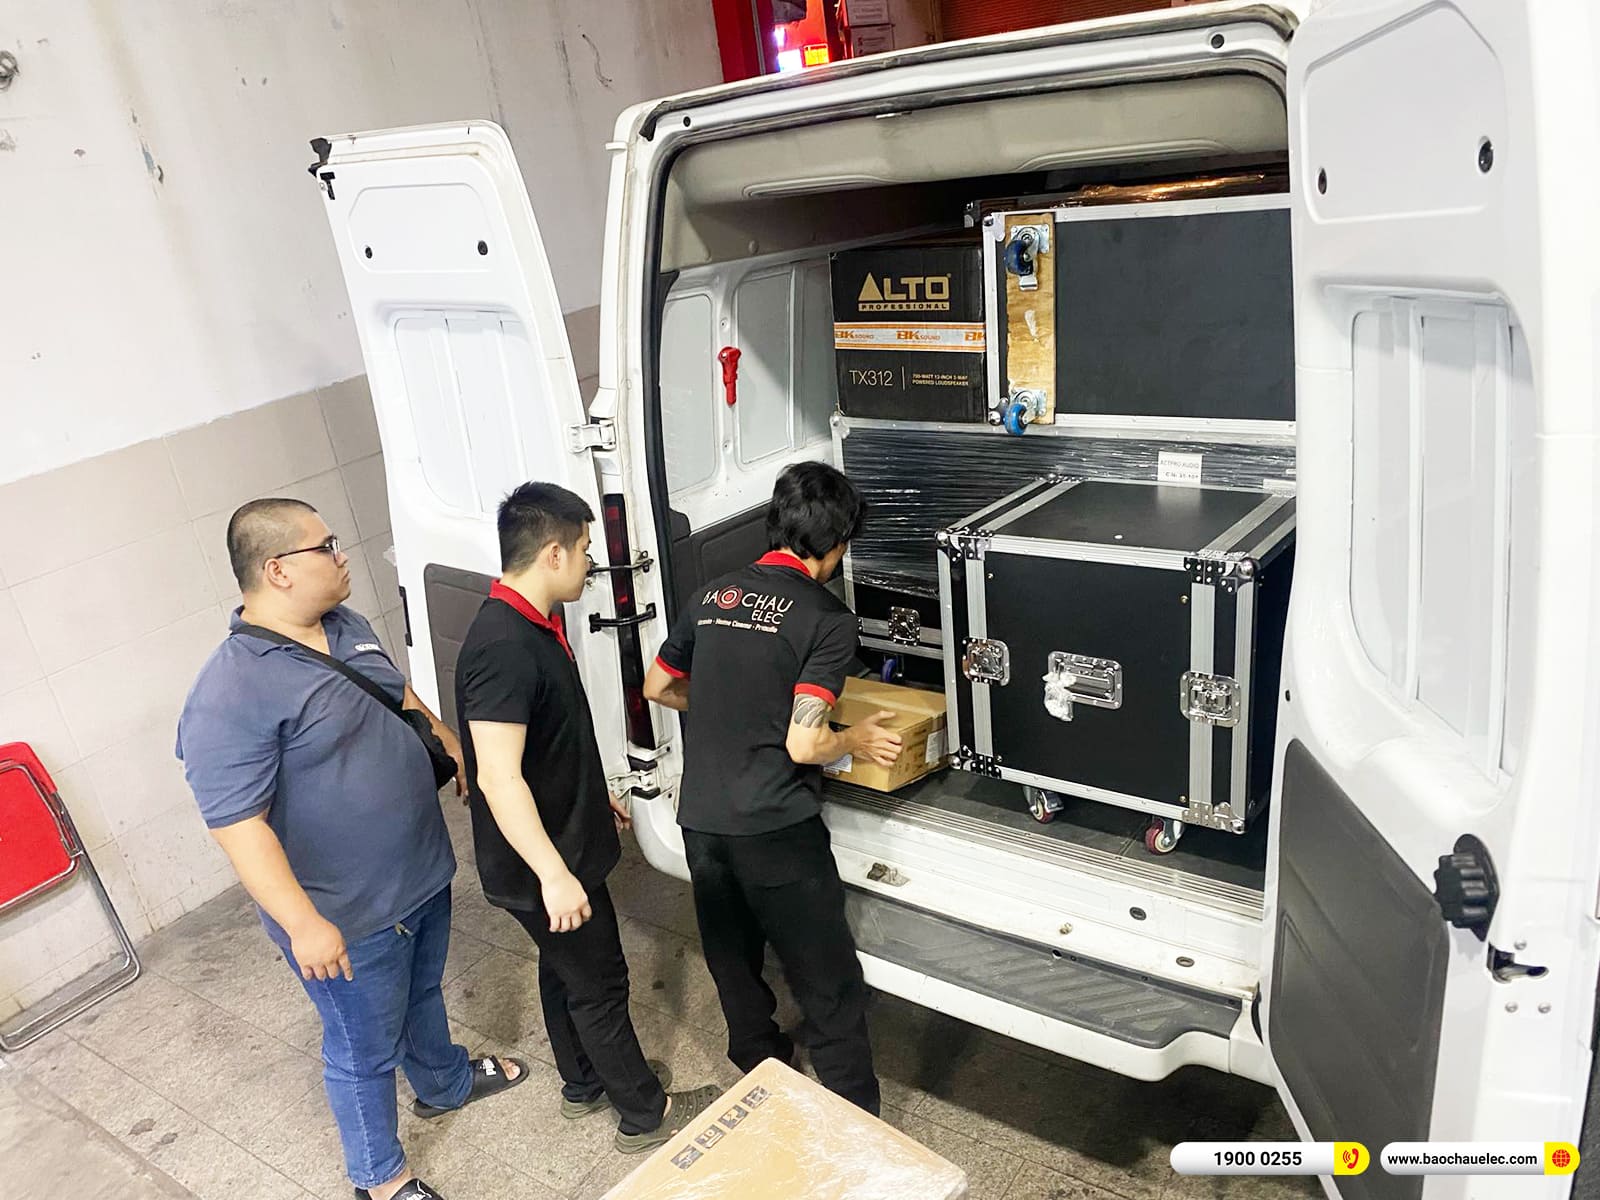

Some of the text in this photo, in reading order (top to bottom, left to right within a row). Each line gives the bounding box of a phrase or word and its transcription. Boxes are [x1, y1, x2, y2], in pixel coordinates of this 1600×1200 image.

[858, 272, 950, 301] ALTO
[896, 330, 920, 340] BK
[849, 369, 893, 386] TX312
[741, 593, 794, 612] CHAU
[752, 609, 784, 625] ELEC
